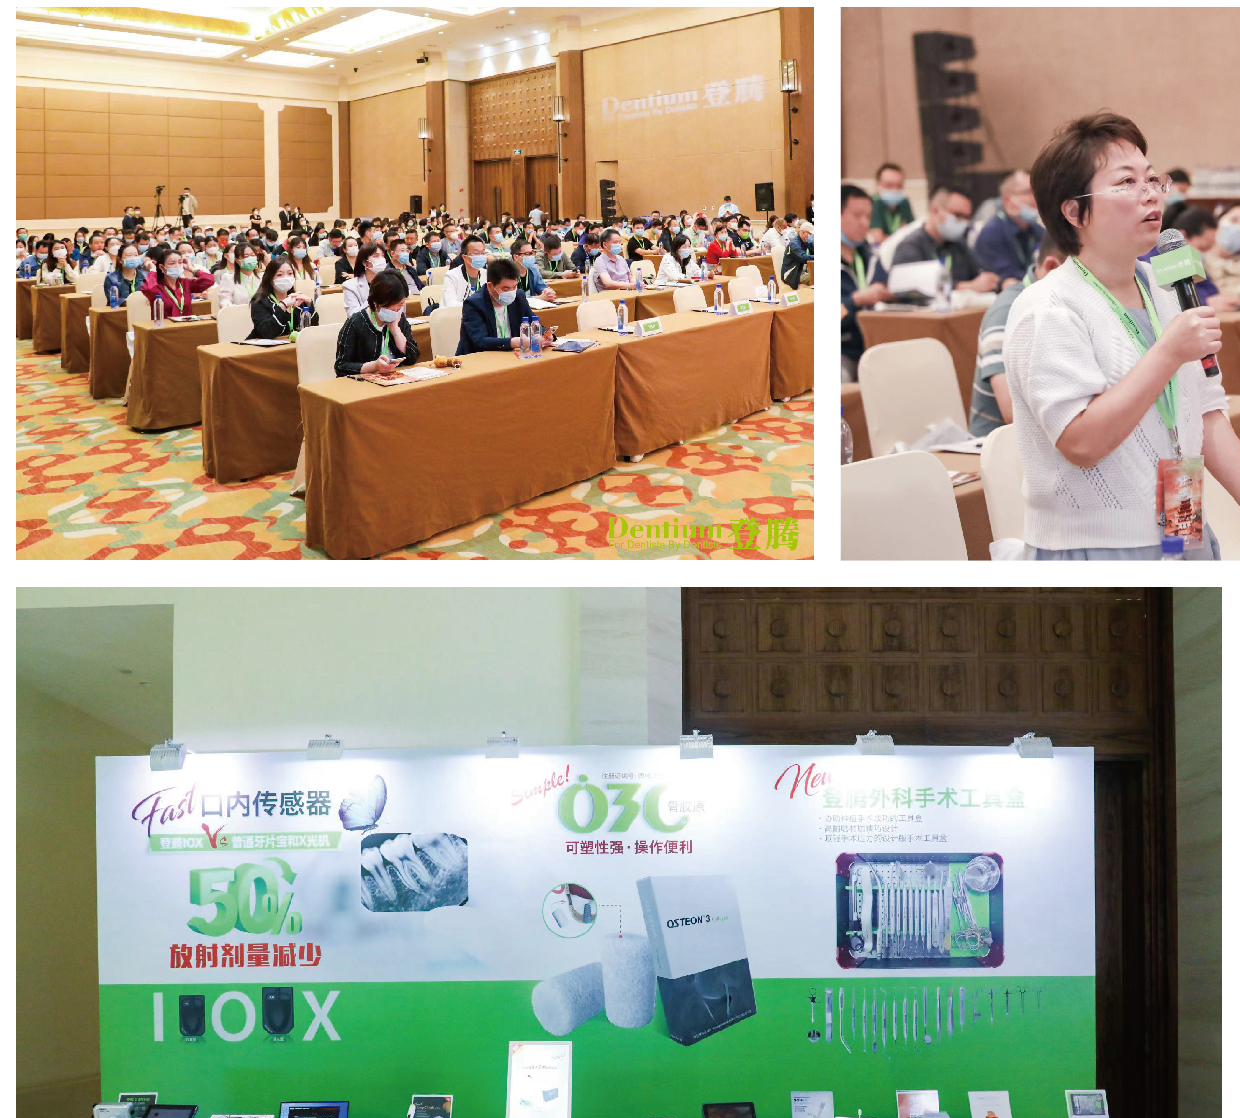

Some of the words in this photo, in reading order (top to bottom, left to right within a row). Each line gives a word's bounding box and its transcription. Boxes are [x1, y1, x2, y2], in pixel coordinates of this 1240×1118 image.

[601, 90, 698, 116] Dentium
[201, 790, 332, 817] 口内传感器
[231, 834, 330, 849] 普通牙片宝和X光机
[565, 840, 693, 855] 可塑性强·操作便利
[186, 862, 303, 937] 50%
[169, 943, 322, 969] 放射剂量减少
